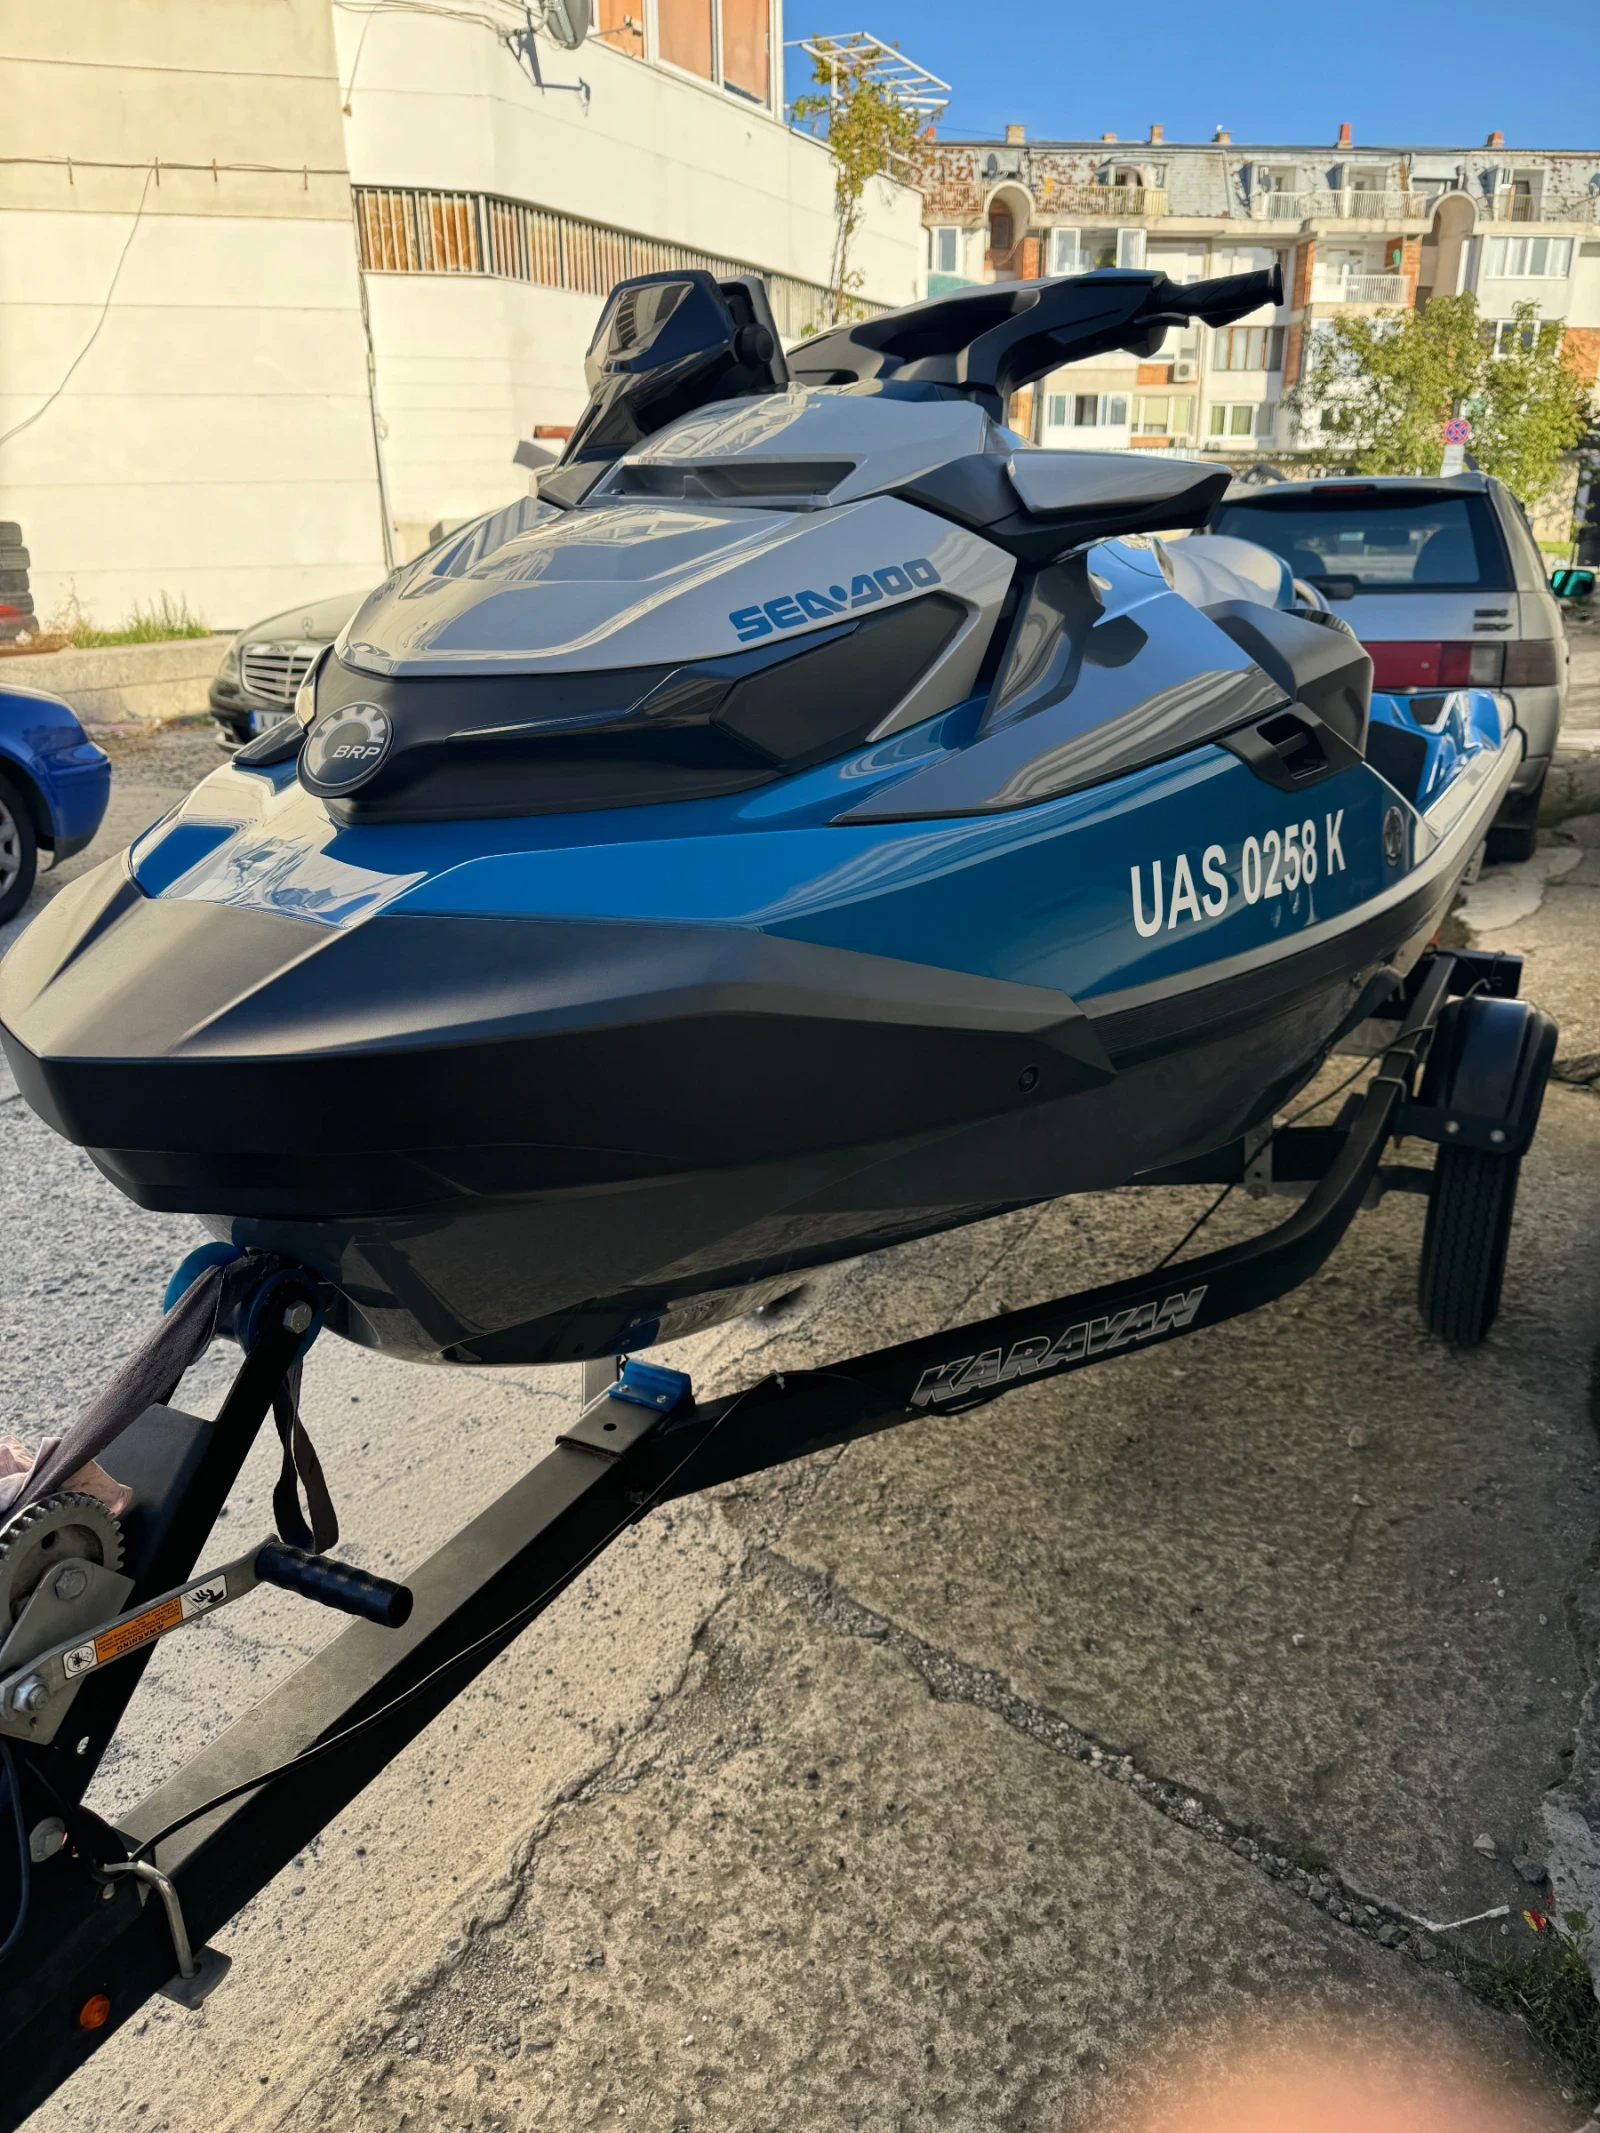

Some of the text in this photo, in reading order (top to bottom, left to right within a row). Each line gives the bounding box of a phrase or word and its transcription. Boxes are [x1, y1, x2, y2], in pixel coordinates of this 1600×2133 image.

[332, 745, 381, 760] BRP
[1131, 809, 1346, 937] UAS 0258 K
[910, 1285, 1208, 1406] KARAVAN
[116, 1627, 157, 1651] WARNING
